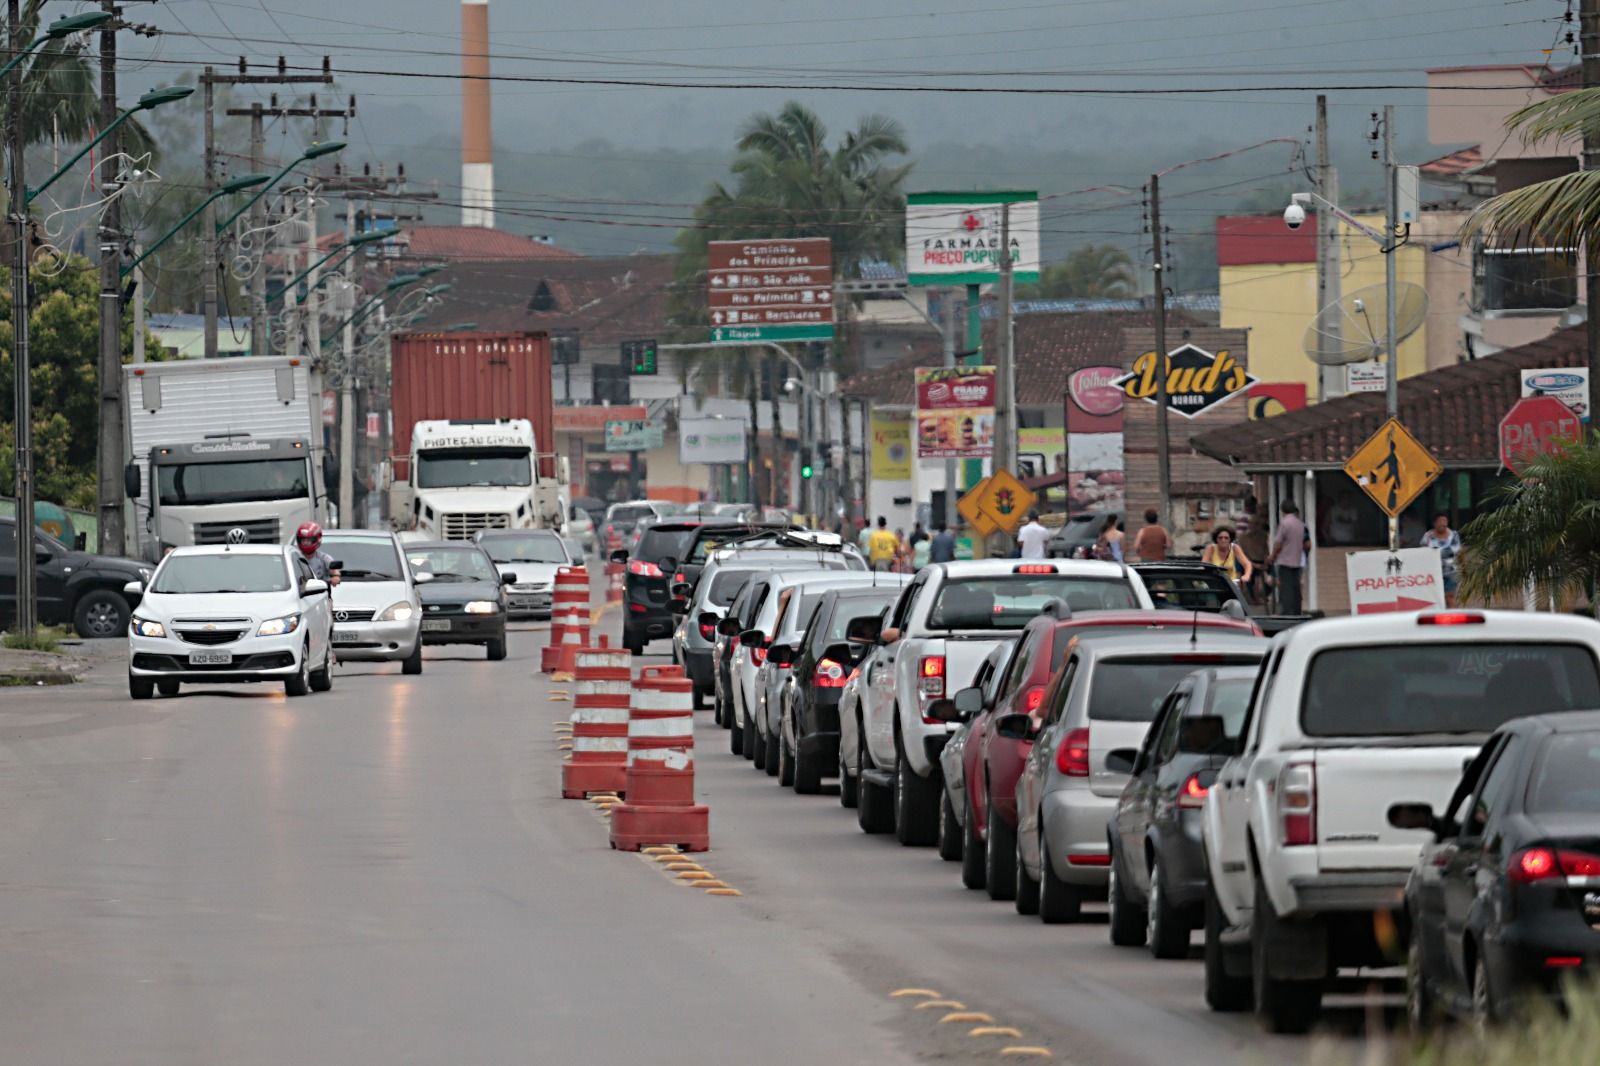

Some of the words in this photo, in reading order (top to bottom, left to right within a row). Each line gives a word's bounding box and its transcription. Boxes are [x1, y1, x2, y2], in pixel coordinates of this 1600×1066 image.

[923, 239, 1018, 249] FARMACA
[729, 257, 748, 266] dos
[786, 273, 810, 284] João
[732, 294, 748, 304] Rio
[754, 292, 797, 303] Palmital
[1124, 350, 1246, 398] Dud's
[1172, 395, 1204, 406] BURGER
